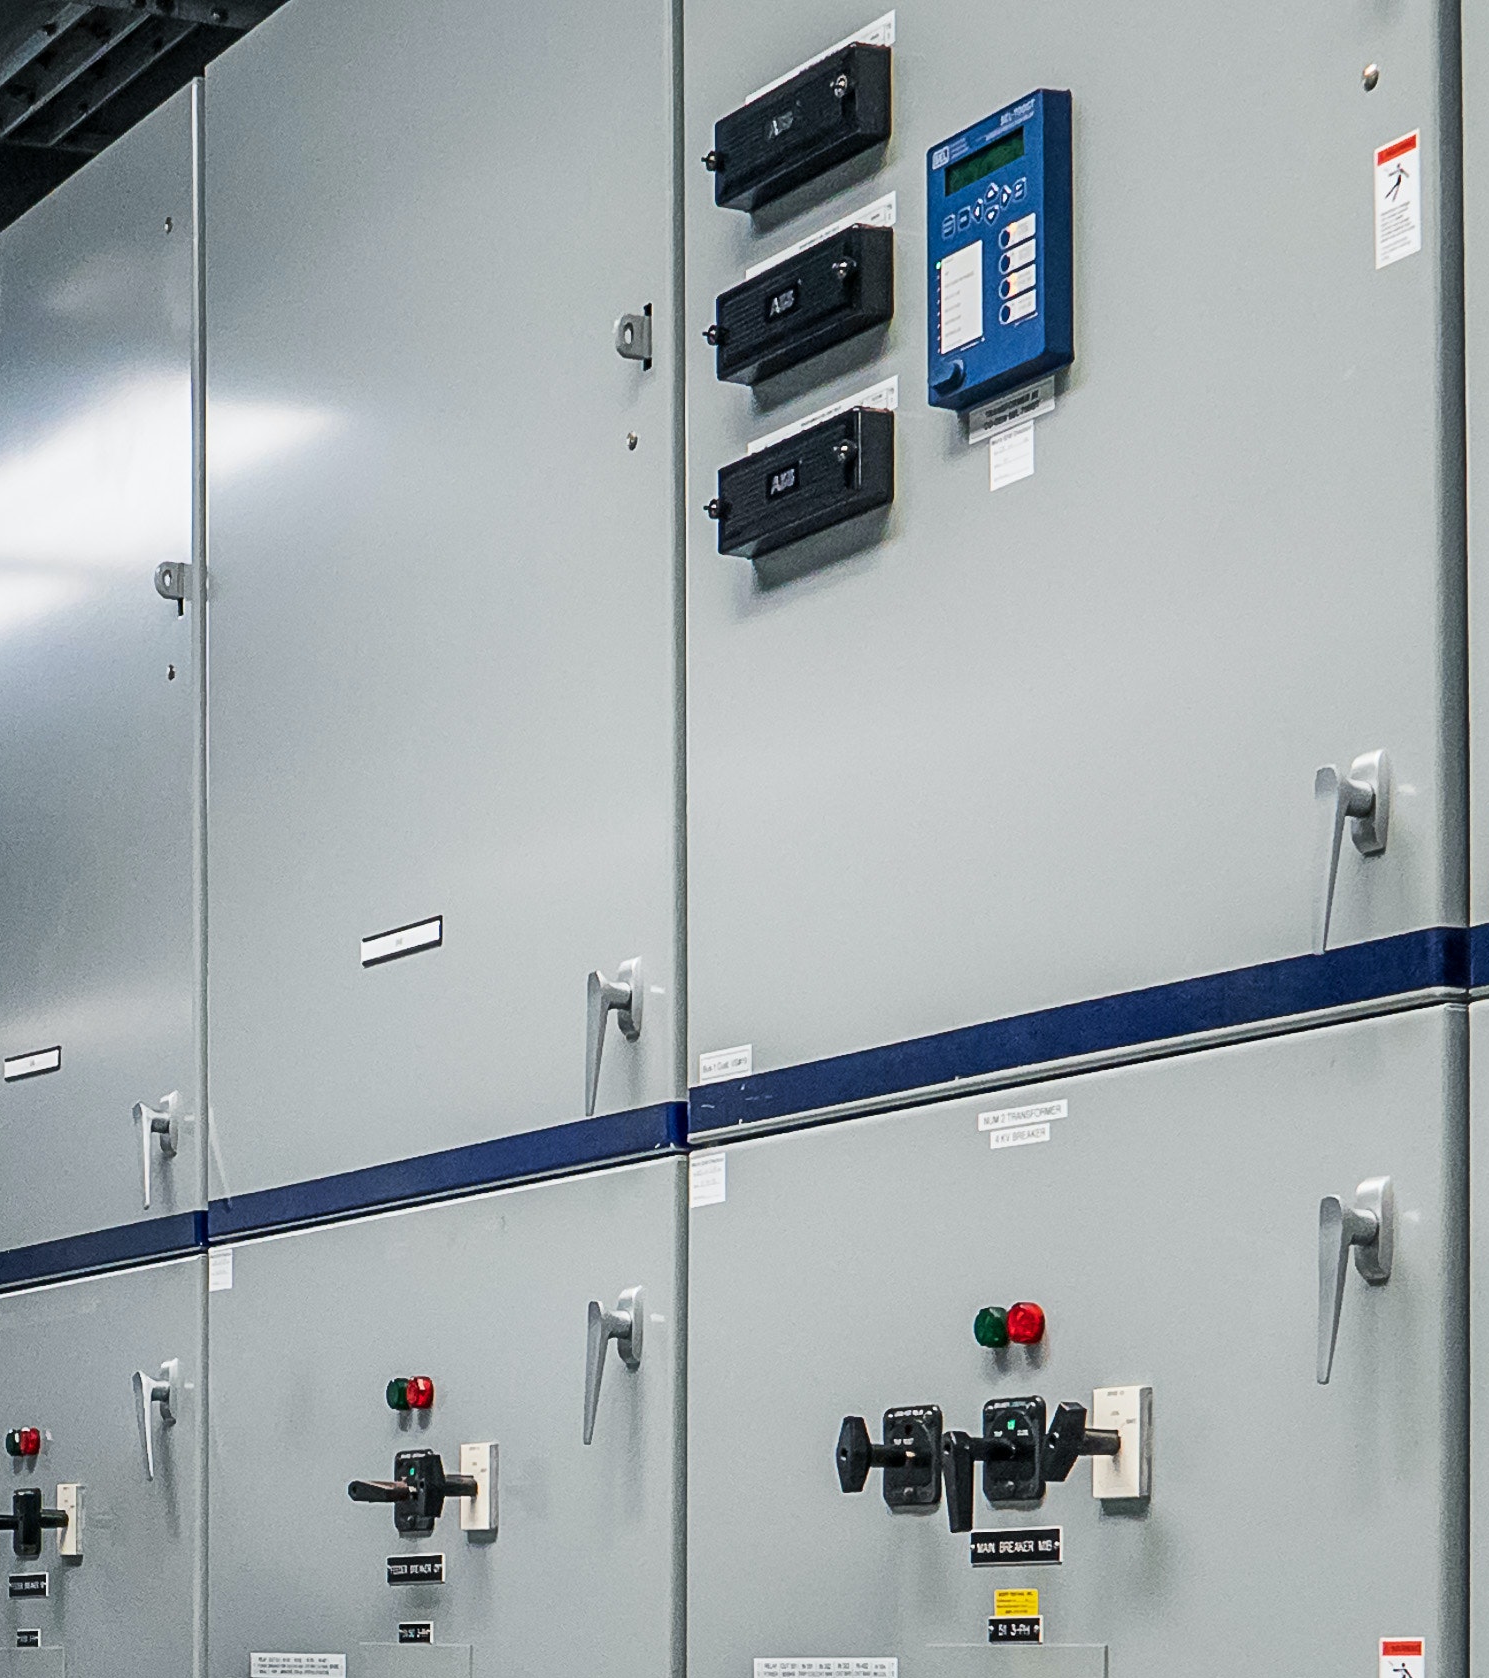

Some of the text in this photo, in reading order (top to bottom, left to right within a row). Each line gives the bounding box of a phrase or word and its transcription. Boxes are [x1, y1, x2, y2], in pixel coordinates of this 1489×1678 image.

[1008, 1104, 1062, 1121] TRANSFORMER
[1012, 1127, 1046, 1141] BREAKER
[976, 1542, 996, 1554] MAIN
[998, 1540, 1034, 1553] BREAKER
